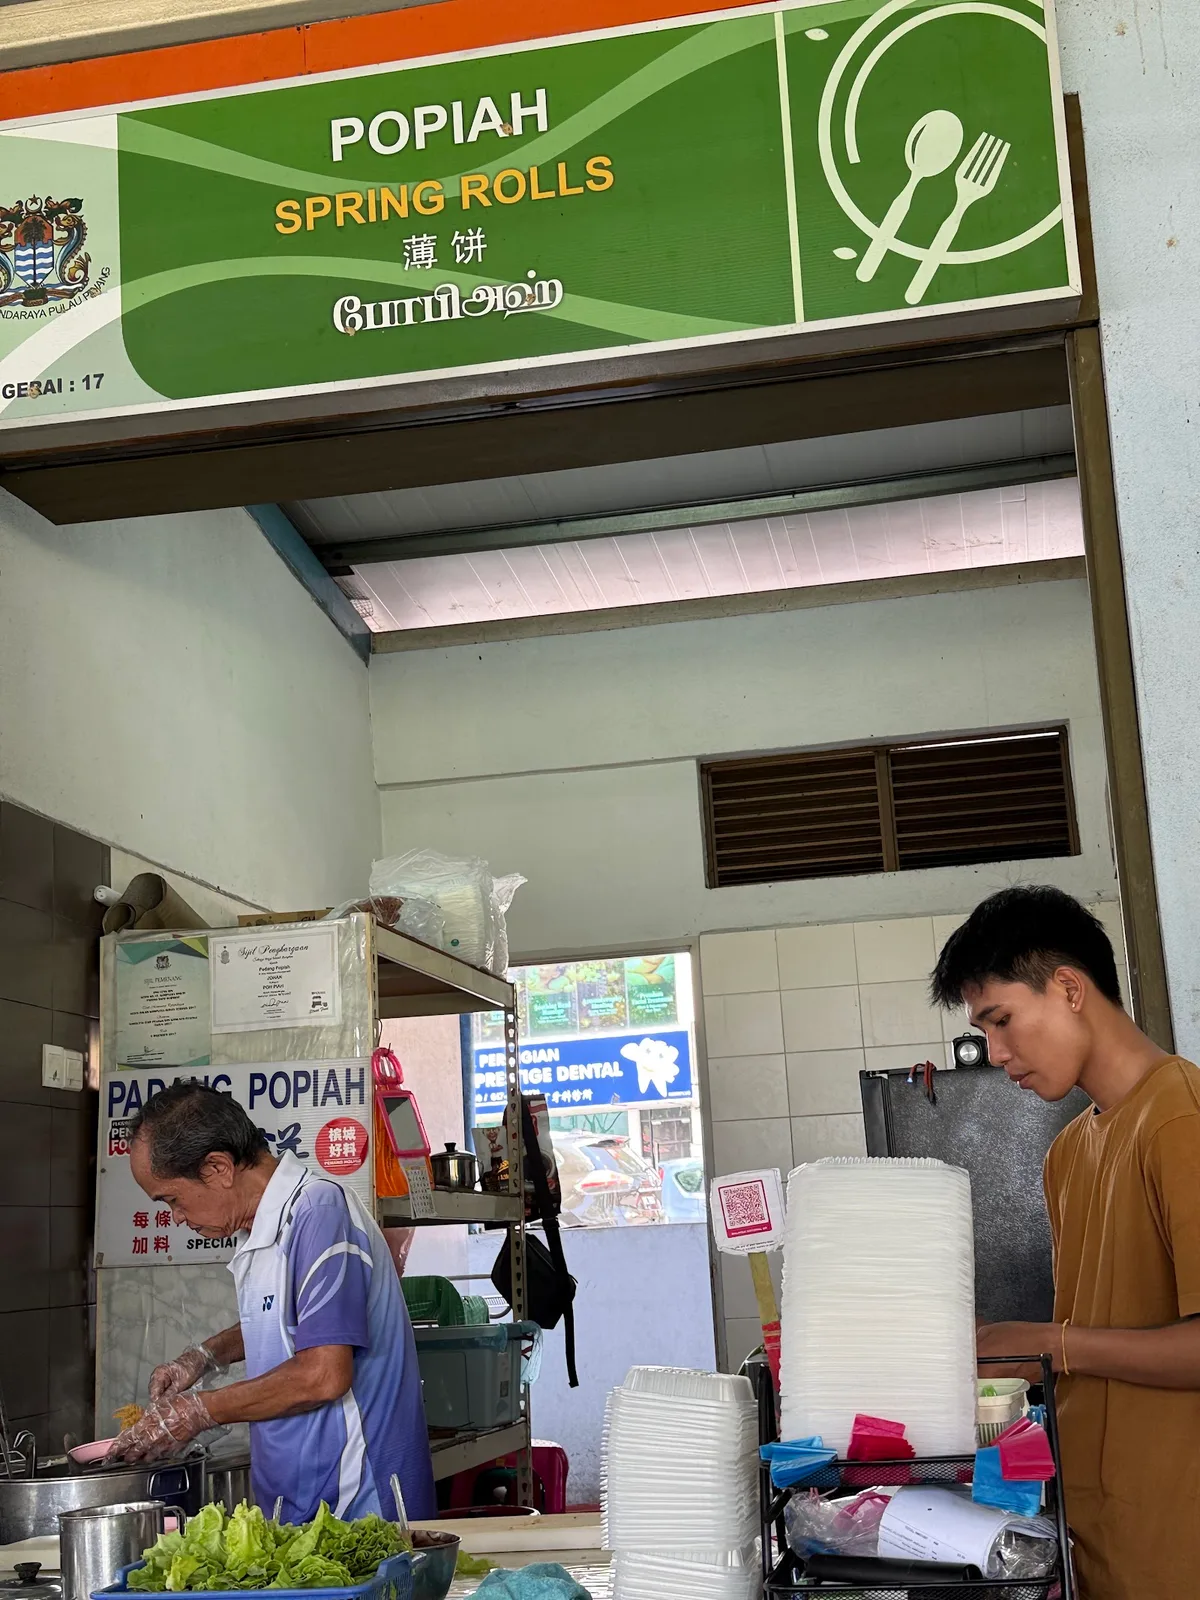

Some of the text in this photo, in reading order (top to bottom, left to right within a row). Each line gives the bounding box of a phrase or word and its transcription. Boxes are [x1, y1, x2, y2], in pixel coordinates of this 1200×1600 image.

[331, 88, 548, 161] POPIAH
[274, 156, 615, 234] SPRING ROLLS
[402, 226, 488, 271] 薄饼
[48, 297, 83, 316] PULAU
[82, 373, 105, 391] 17
[479, 1048, 560, 1068] PERGIAN
[556, 1061, 624, 1082] DENTAL
[249, 1067, 365, 1110] POPIAH
[132, 1235, 170, 1254] 加料
